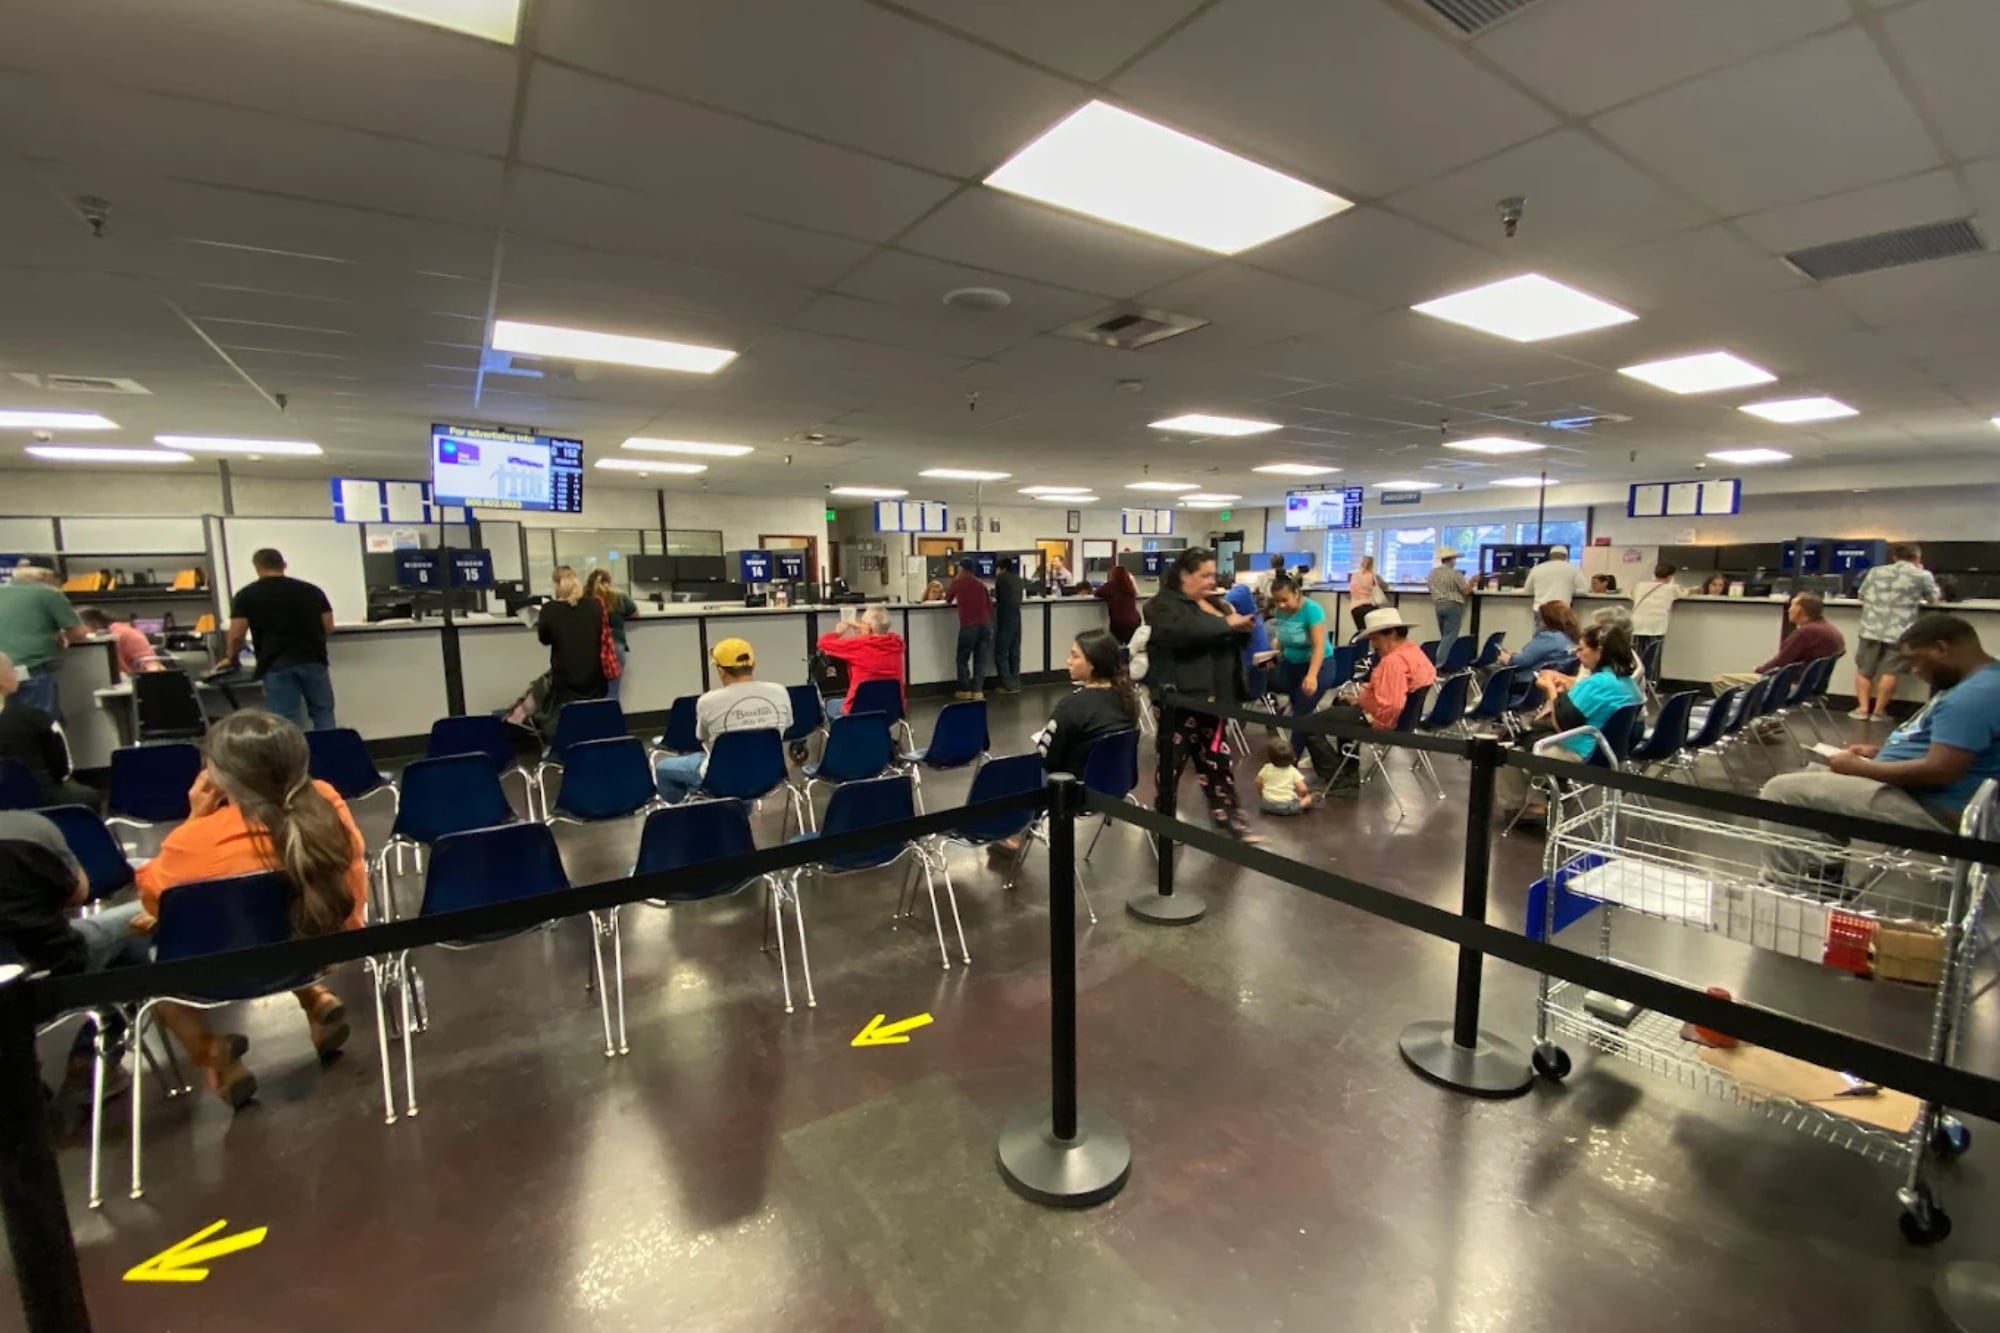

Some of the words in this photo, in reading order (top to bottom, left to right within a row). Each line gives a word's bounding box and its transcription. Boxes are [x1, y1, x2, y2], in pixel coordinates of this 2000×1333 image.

[449, 427, 465, 436] For
[467, 428, 515, 443] advertising
[419, 569, 429, 583] 6
[463, 567, 480, 582] 15
[751, 565, 764, 577] 14
